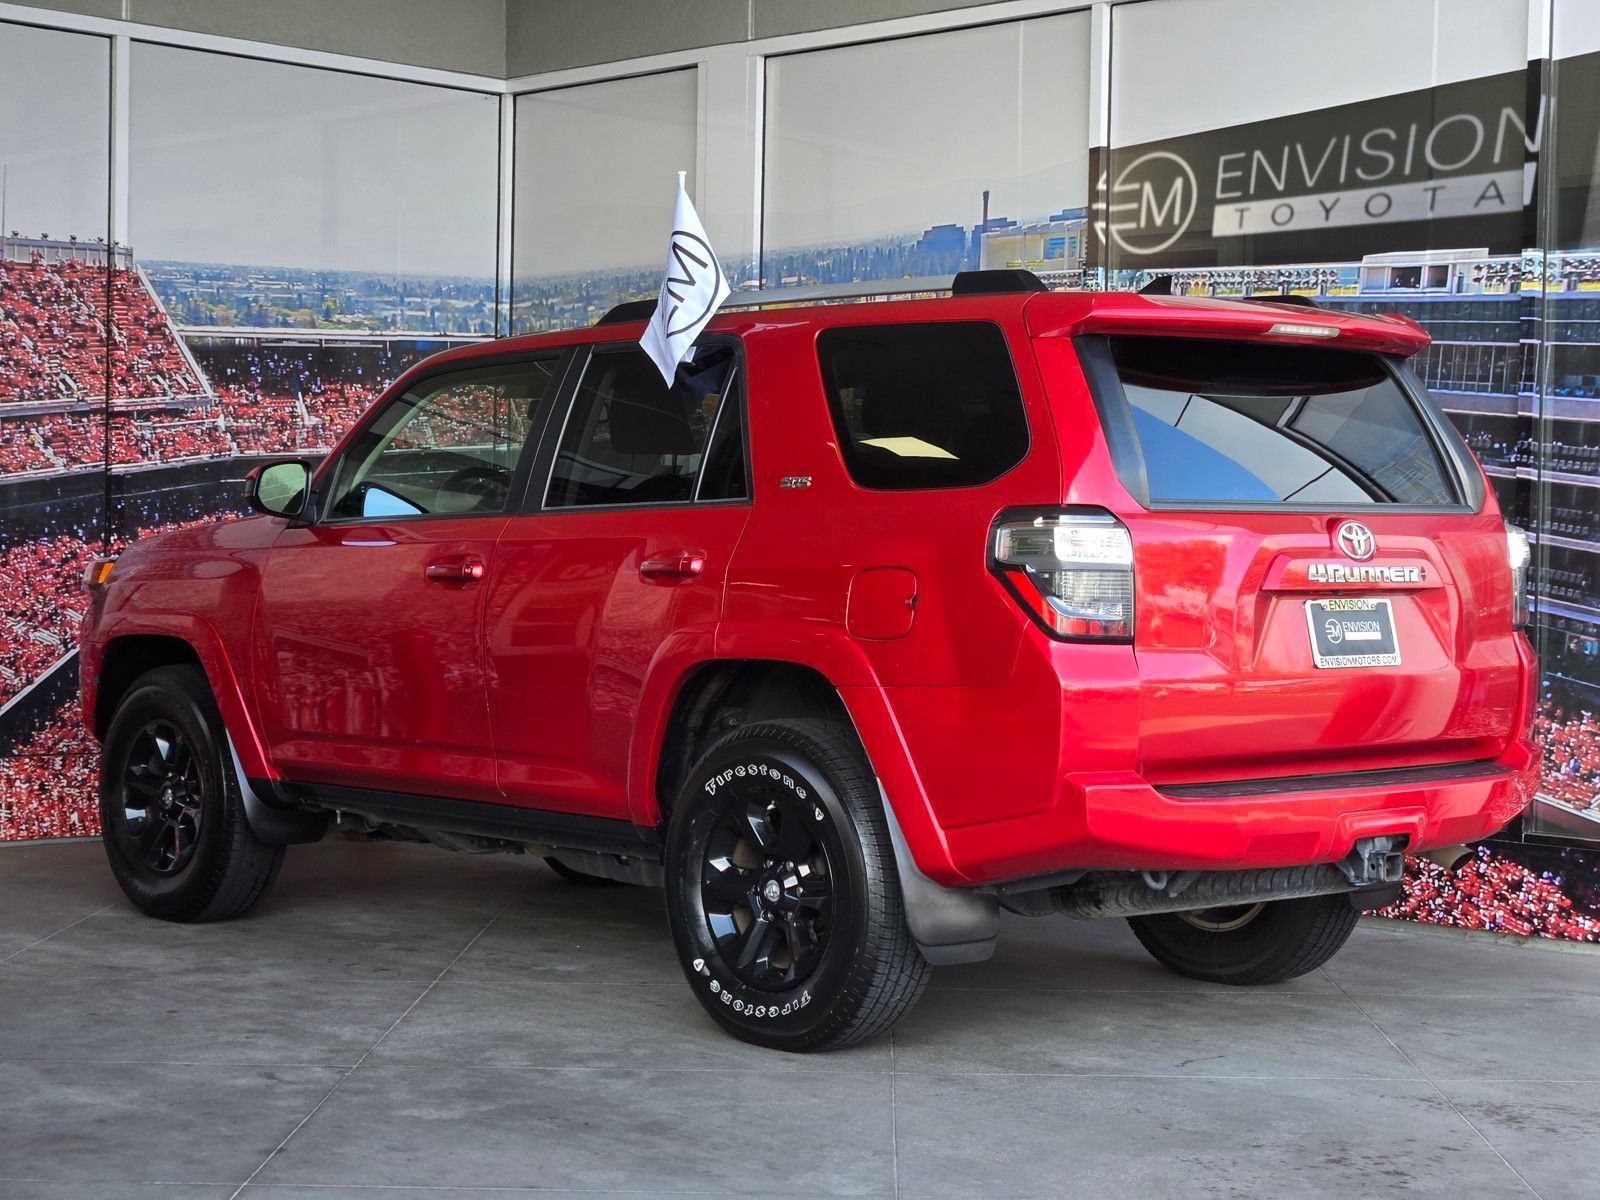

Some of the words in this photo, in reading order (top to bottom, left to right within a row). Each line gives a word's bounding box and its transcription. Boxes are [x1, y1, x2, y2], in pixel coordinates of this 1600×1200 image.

[1215, 94, 1547, 200] ENVISION
[1234, 179, 1506, 231] TOYOTA
[1328, 599, 1369, 610] ENVISION
[1342, 621, 1380, 632] ENVISION
[1320, 655, 1397, 667] ENVISIONMOTORS.COM
[705, 763, 807, 799] Firestone
